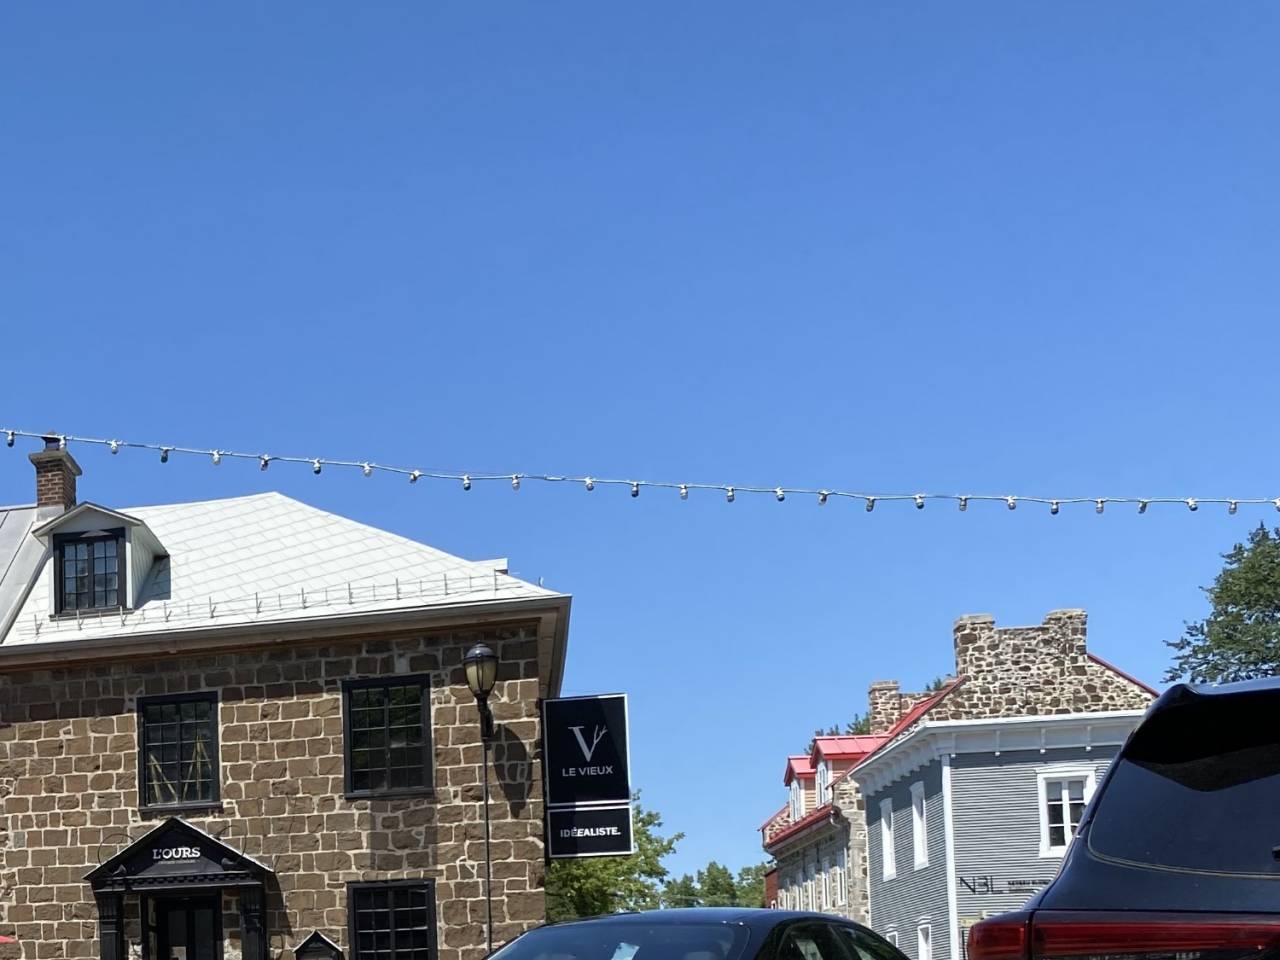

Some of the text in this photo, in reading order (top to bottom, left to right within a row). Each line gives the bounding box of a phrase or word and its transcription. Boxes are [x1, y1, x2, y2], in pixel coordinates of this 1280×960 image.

[561, 765, 614, 777] LE VIEUX
[152, 846, 201, 860] L'OURS
